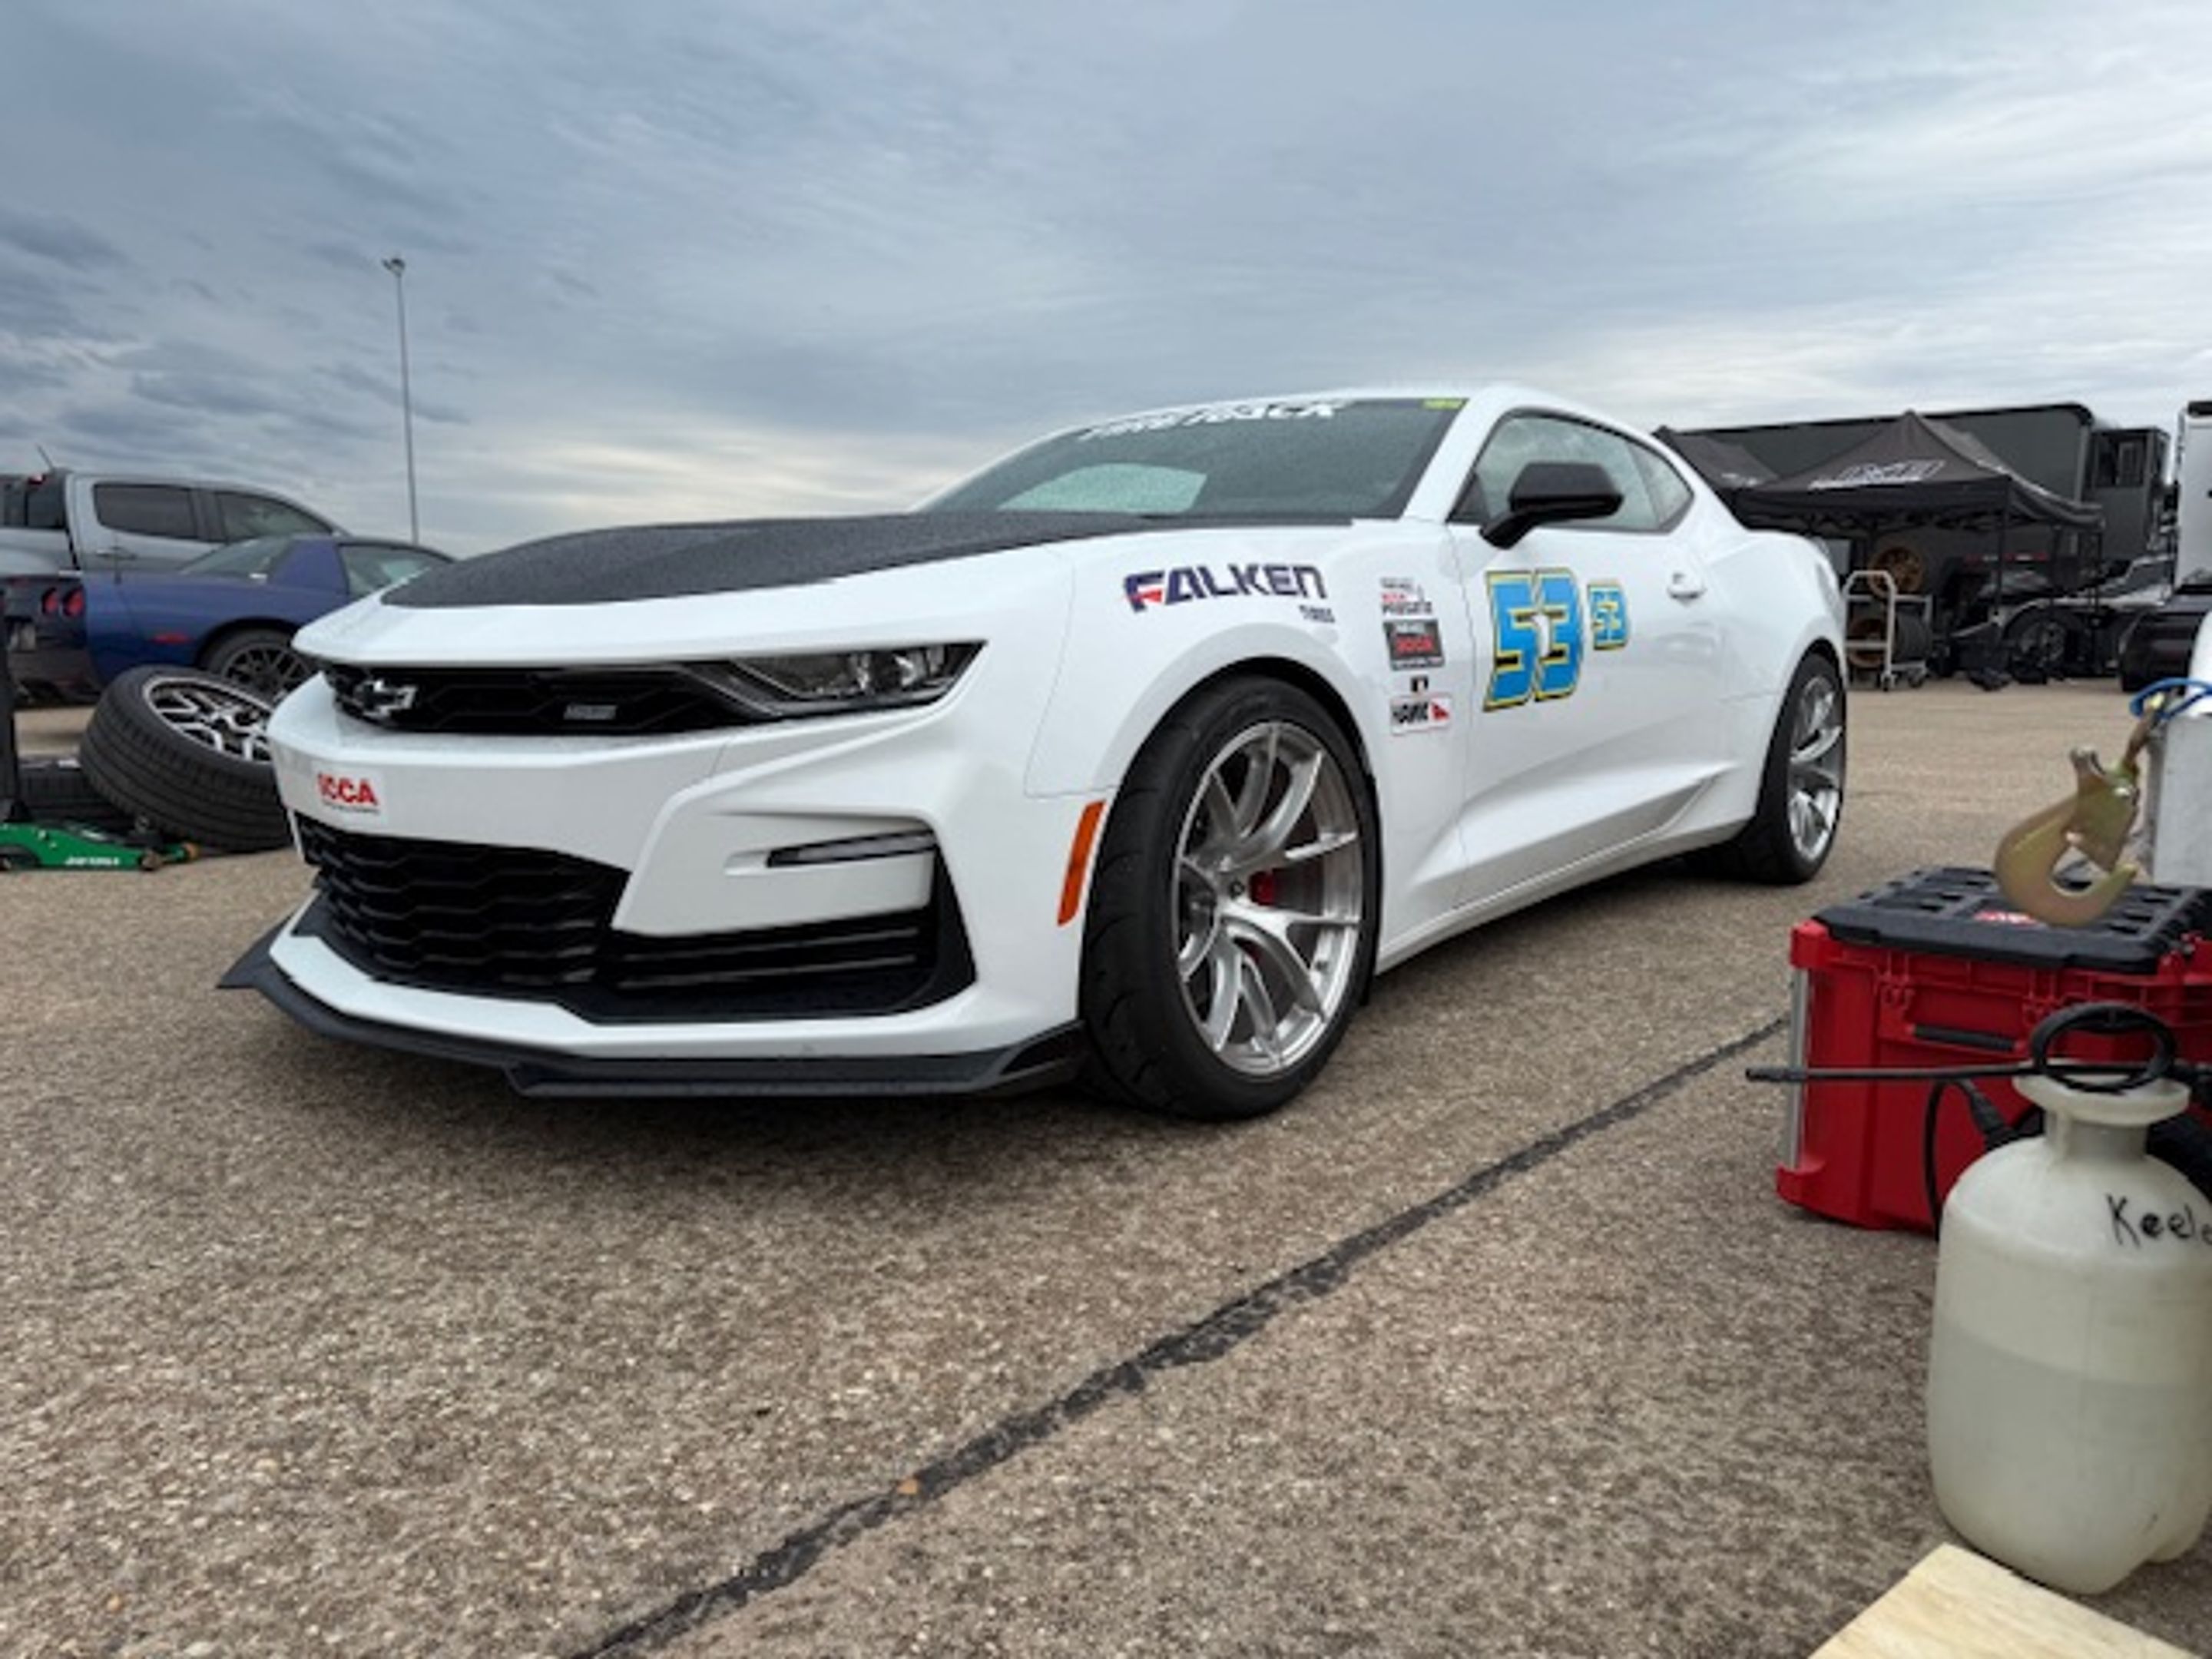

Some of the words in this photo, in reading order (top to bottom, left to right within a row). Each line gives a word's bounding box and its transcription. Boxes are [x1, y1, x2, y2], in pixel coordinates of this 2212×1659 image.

[1124, 563, 1326, 613] FALKEN
[1587, 579, 1630, 651] 53
[1482, 567, 1584, 712] 53
